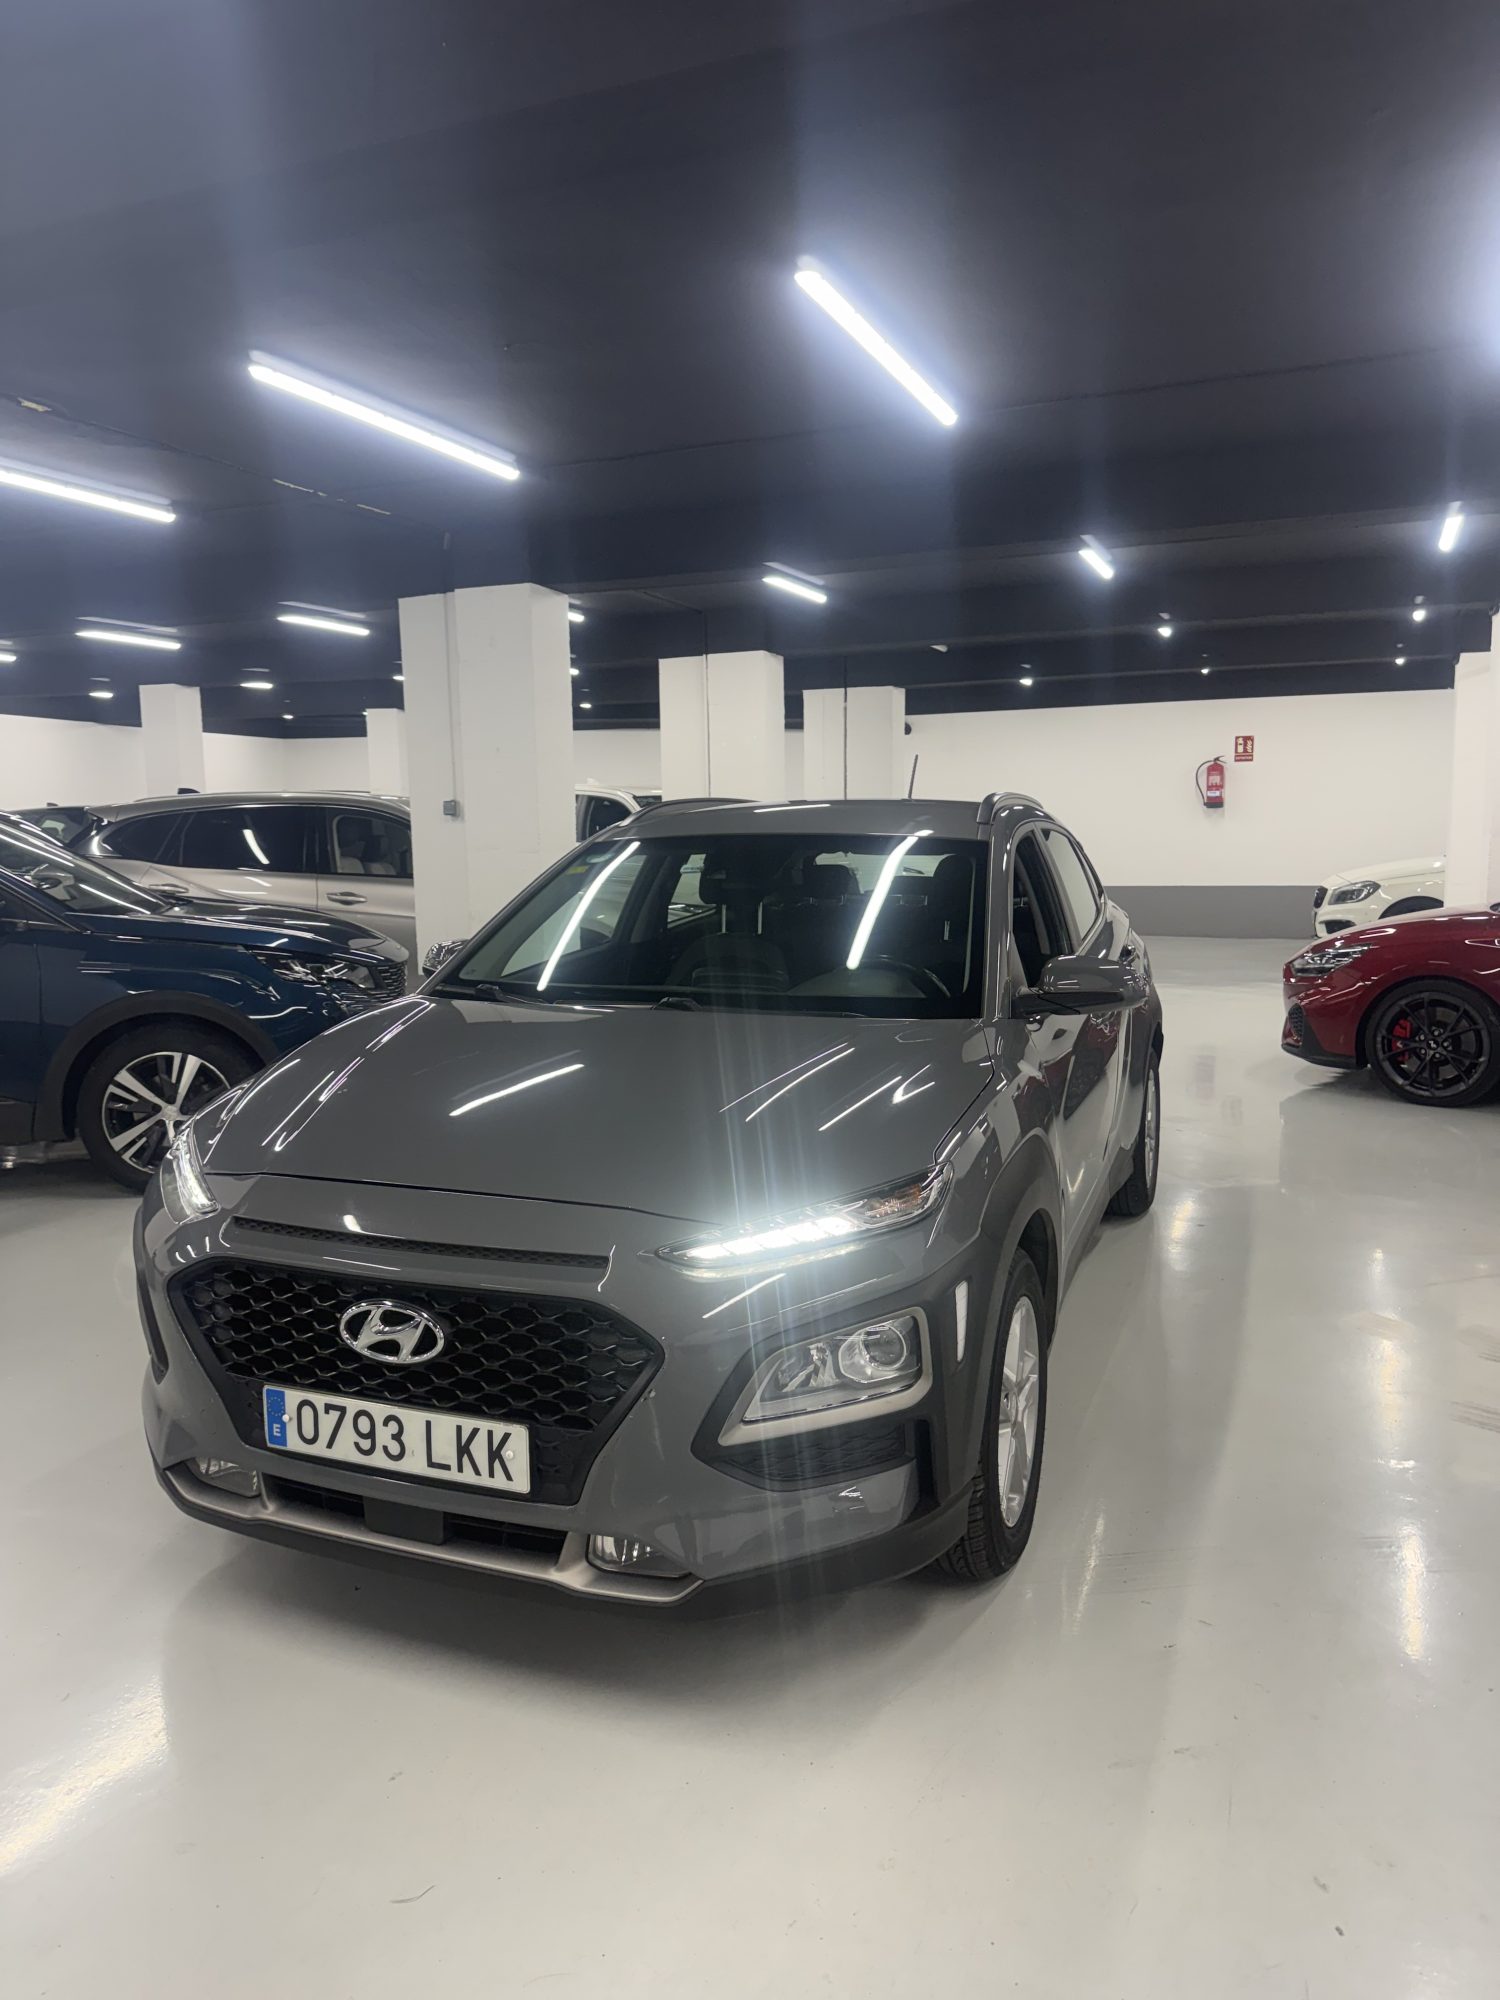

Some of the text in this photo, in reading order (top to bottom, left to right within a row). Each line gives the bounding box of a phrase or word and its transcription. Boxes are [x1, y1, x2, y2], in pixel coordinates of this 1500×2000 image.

[273, 1424, 281, 1437] E
[296, 1399, 514, 1482] 0793 LKK
